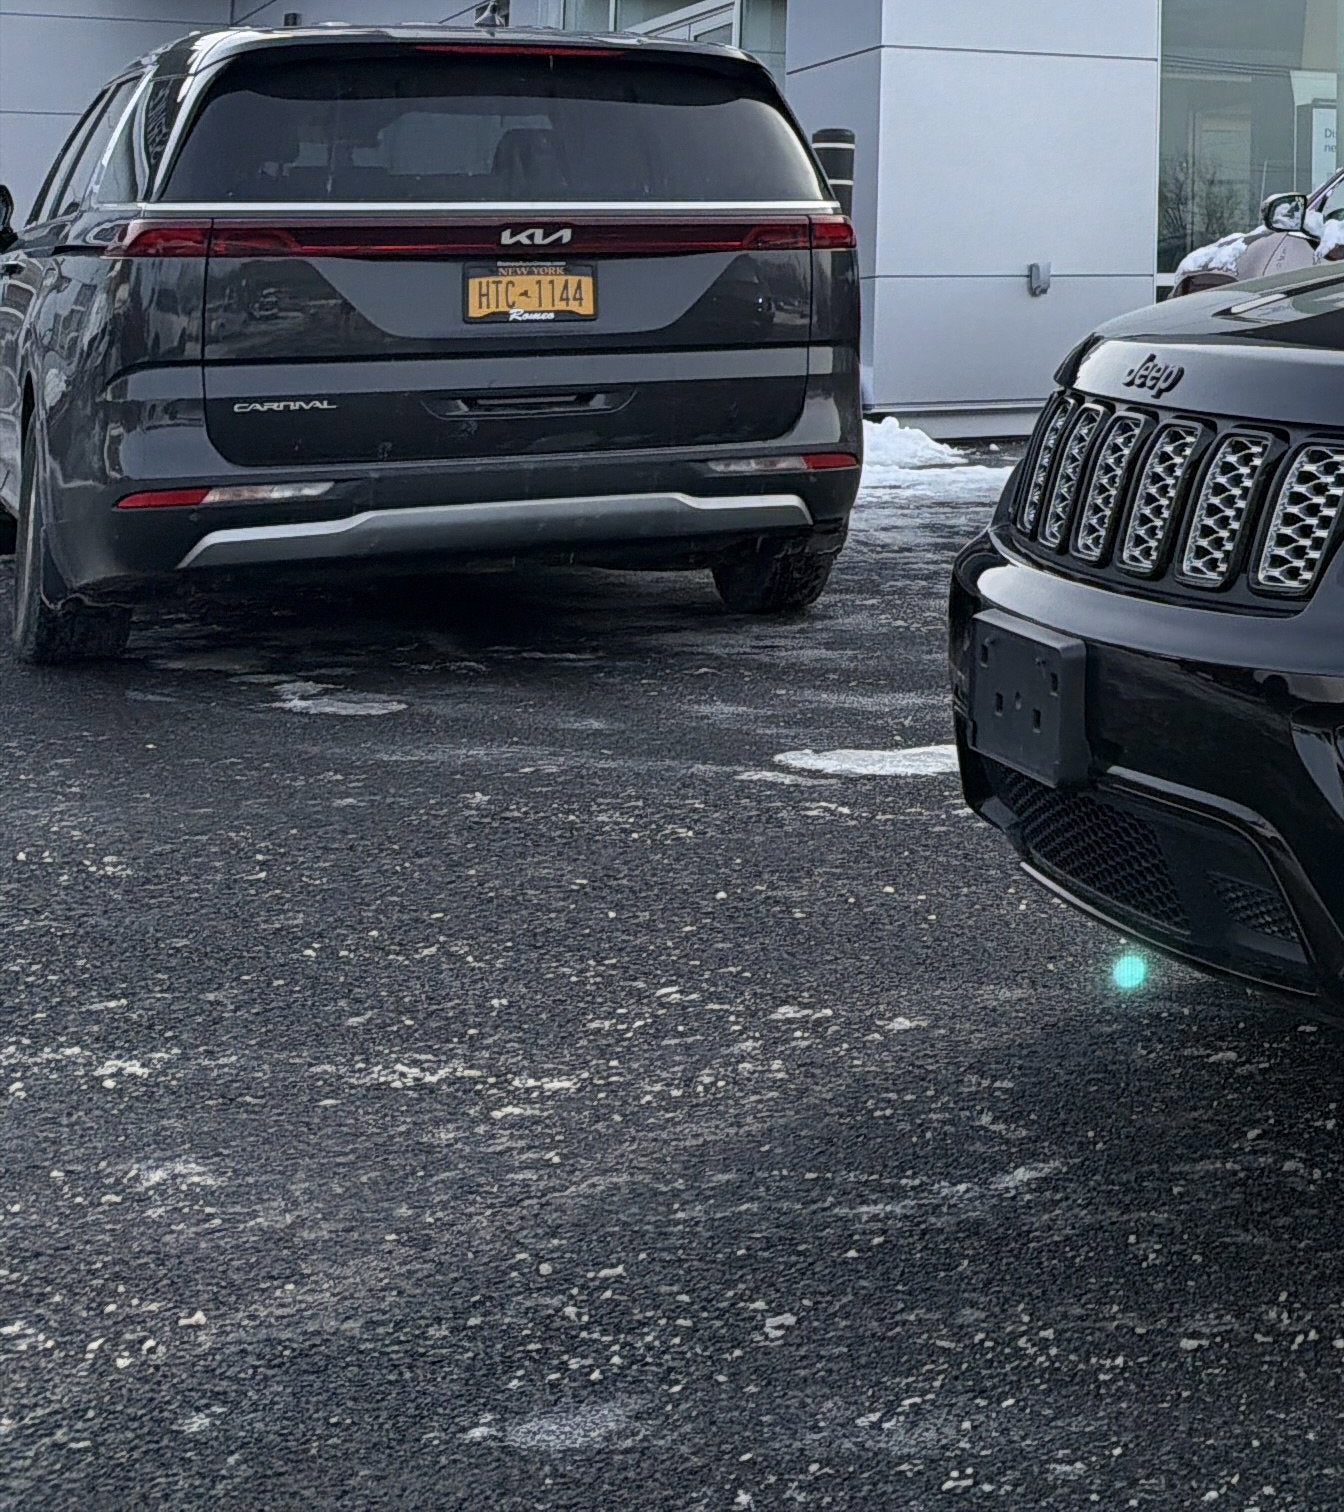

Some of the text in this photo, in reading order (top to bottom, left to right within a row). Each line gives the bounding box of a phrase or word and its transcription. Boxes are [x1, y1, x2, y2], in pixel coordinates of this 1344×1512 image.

[501, 228, 572, 245] KIA
[498, 266, 565, 276] NEW YORK
[508, 308, 555, 321] Romeo
[1122, 352, 1185, 399] Jeep
[233, 400, 338, 413] CARNIVAL
